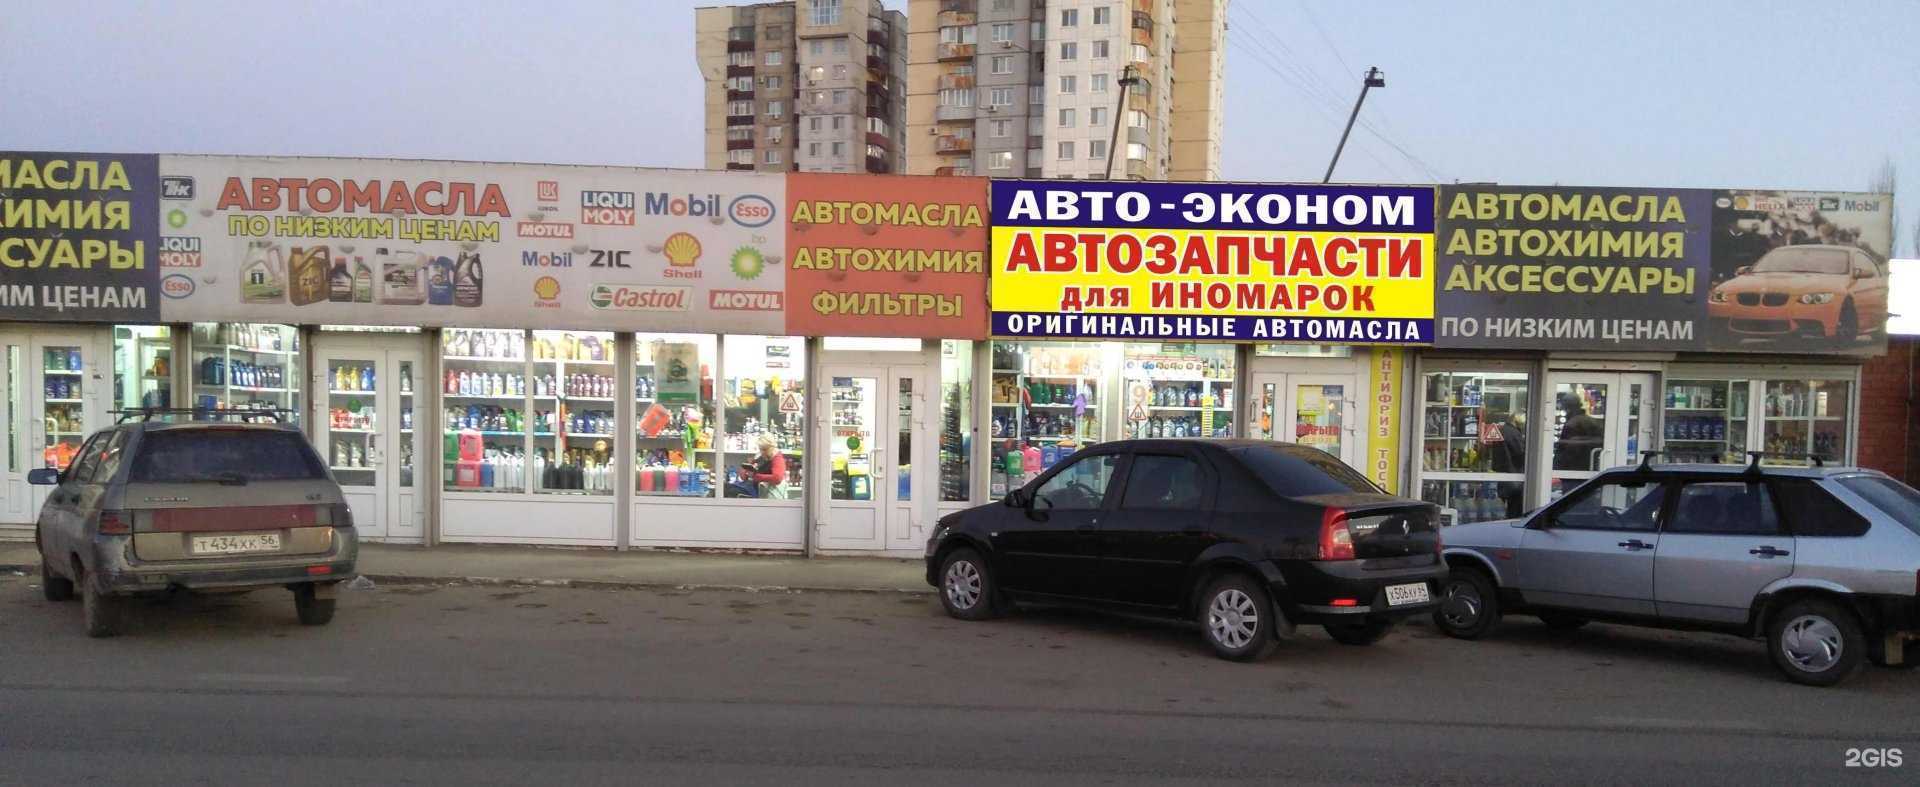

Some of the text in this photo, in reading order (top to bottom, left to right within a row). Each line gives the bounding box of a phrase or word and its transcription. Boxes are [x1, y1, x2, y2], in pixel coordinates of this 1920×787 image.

[216, 177, 511, 217] АВТОМАСЛА
[583, 192, 633, 208] LIQUI
[645, 192, 720, 216] Mobil
[1448, 193, 1685, 223] АВТОМАСЛА
[1844, 200, 1879, 212] Mobil
[0, 199, 130, 230] ИМИЯ
[583, 209, 634, 225] MOLY
[792, 200, 983, 227] АВТОМАСЛА
[227, 215, 499, 243] ПО НИЗКИМ ЦЕНАМ
[520, 224, 572, 236] MOTUL
[160, 239, 199, 251] IQUI
[1006, 233, 1421, 278] АВТОЗАПЧАСТИ
[1446, 229, 1684, 258] АВТОХИМИЯ
[522, 251, 572, 267] Mobil
[590, 250, 632, 268] ZIC
[792, 247, 983, 273] АВТОХИМИЯ
[663, 268, 702, 279] Shell
[1444, 265, 1695, 294] АКСЕССУАРЫ
[43, 285, 146, 312] ЦЕНАМ
[613, 287, 684, 308] Castrol
[711, 292, 780, 308] MOTUL
[812, 291, 962, 317] ФИЛЬТРЫ
[1151, 282, 1375, 311] ИНОМАРОК
[1007, 314, 1421, 340] ОРИГИНАЛЬНЫЕ АВТОМАСЛА
[1441, 317, 1693, 343] ПО НИЗКИМ ЦЕНАМ
[1379, 350, 1392, 437] АНТИФРИЗ
